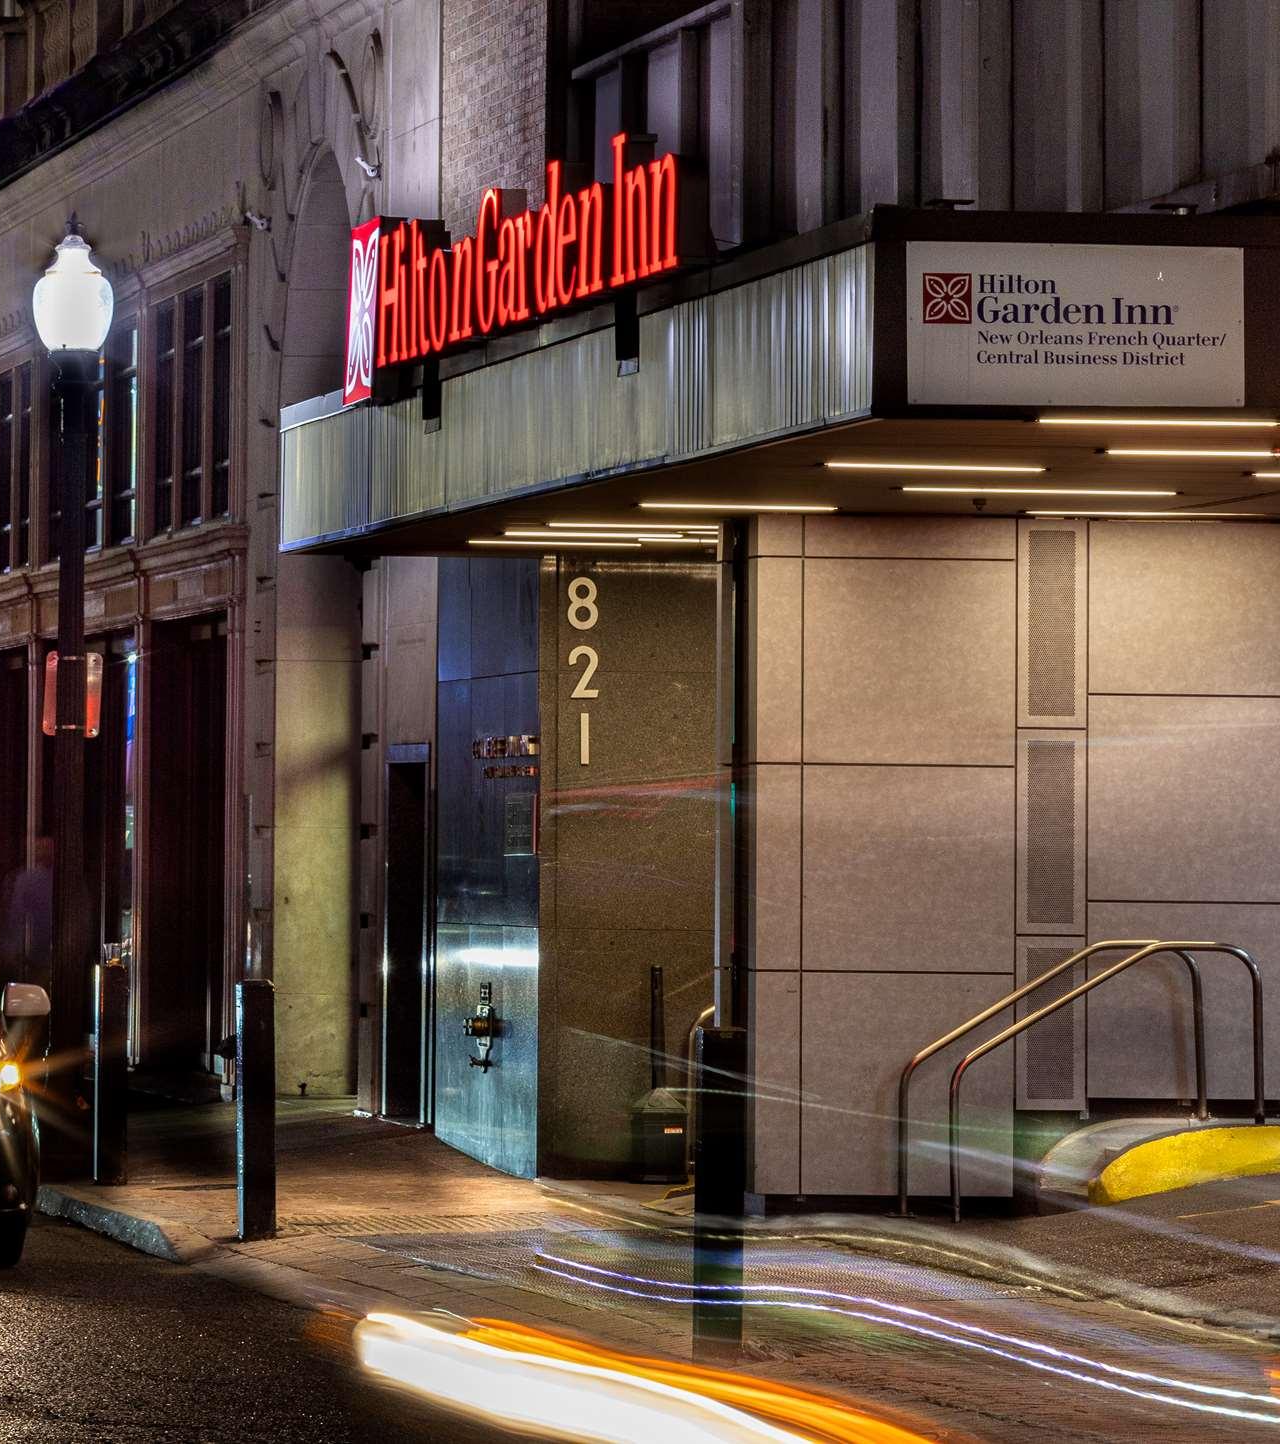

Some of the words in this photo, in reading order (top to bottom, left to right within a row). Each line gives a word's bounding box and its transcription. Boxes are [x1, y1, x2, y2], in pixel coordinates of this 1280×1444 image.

[376, 219, 474, 368] Hilton
[475, 160, 603, 334] Garden
[609, 132, 679, 288] Inn
[977, 274, 1057, 295] Hilton
[976, 296, 1107, 325] Garden
[977, 331, 1012, 346] New
[1017, 331, 1084, 346] Orleans
[1087, 332, 1149, 347] French
[1152, 332, 1227, 349] Quarter/
[976, 350, 1039, 366] Central
[1043, 351, 1119, 366] Business
[1122, 352, 1186, 367] District
[566, 576, 600, 766] 821
